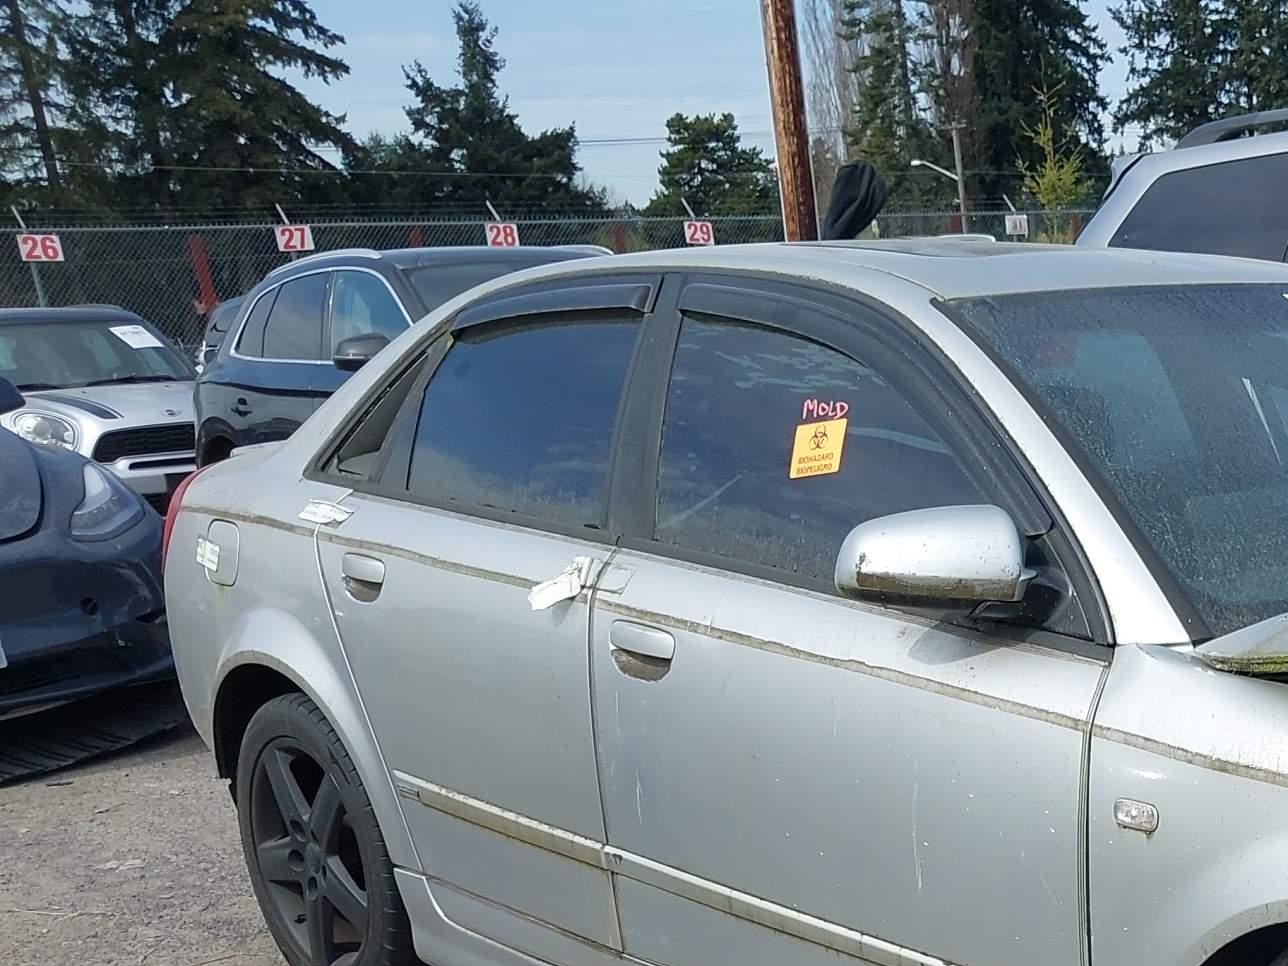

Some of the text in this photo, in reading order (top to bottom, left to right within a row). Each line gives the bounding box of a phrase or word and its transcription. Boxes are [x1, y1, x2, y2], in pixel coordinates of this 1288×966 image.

[281, 227, 307, 249] 27
[489, 225, 516, 245] 28
[687, 223, 712, 243] 29
[23, 236, 60, 260] 26
[802, 398, 849, 419] MOLD
[797, 452, 834, 465] BIOHAZARD
